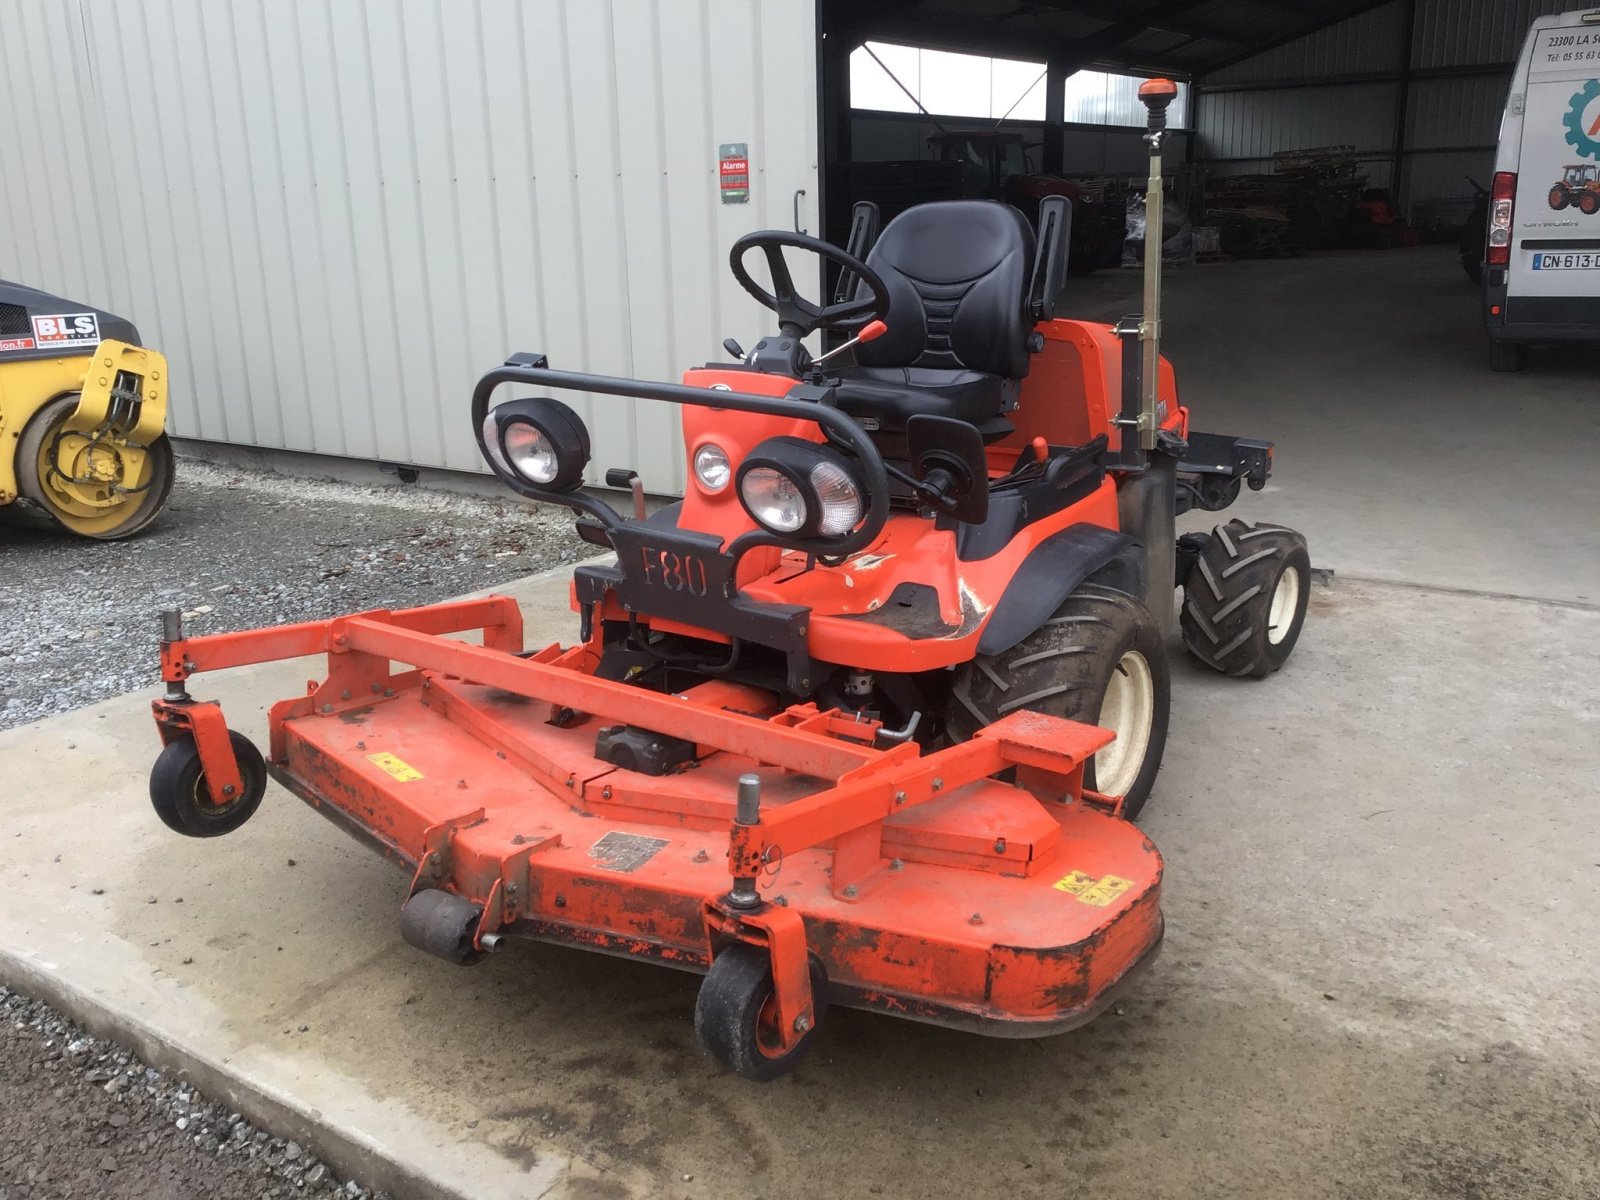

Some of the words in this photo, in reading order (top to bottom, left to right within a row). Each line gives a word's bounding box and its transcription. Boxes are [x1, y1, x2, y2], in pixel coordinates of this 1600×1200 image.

[1548, 35, 1574, 47] 23300
[1577, 35, 1589, 45] LA
[1592, 34, 1600, 44] S
[1563, 53, 1572, 61] 05
[1575, 51, 1584, 60] 55
[1586, 51, 1595, 60] 63
[723, 161, 745, 170] Alarme
[37, 316, 94, 336] BLS
[641, 546, 707, 597] F80
